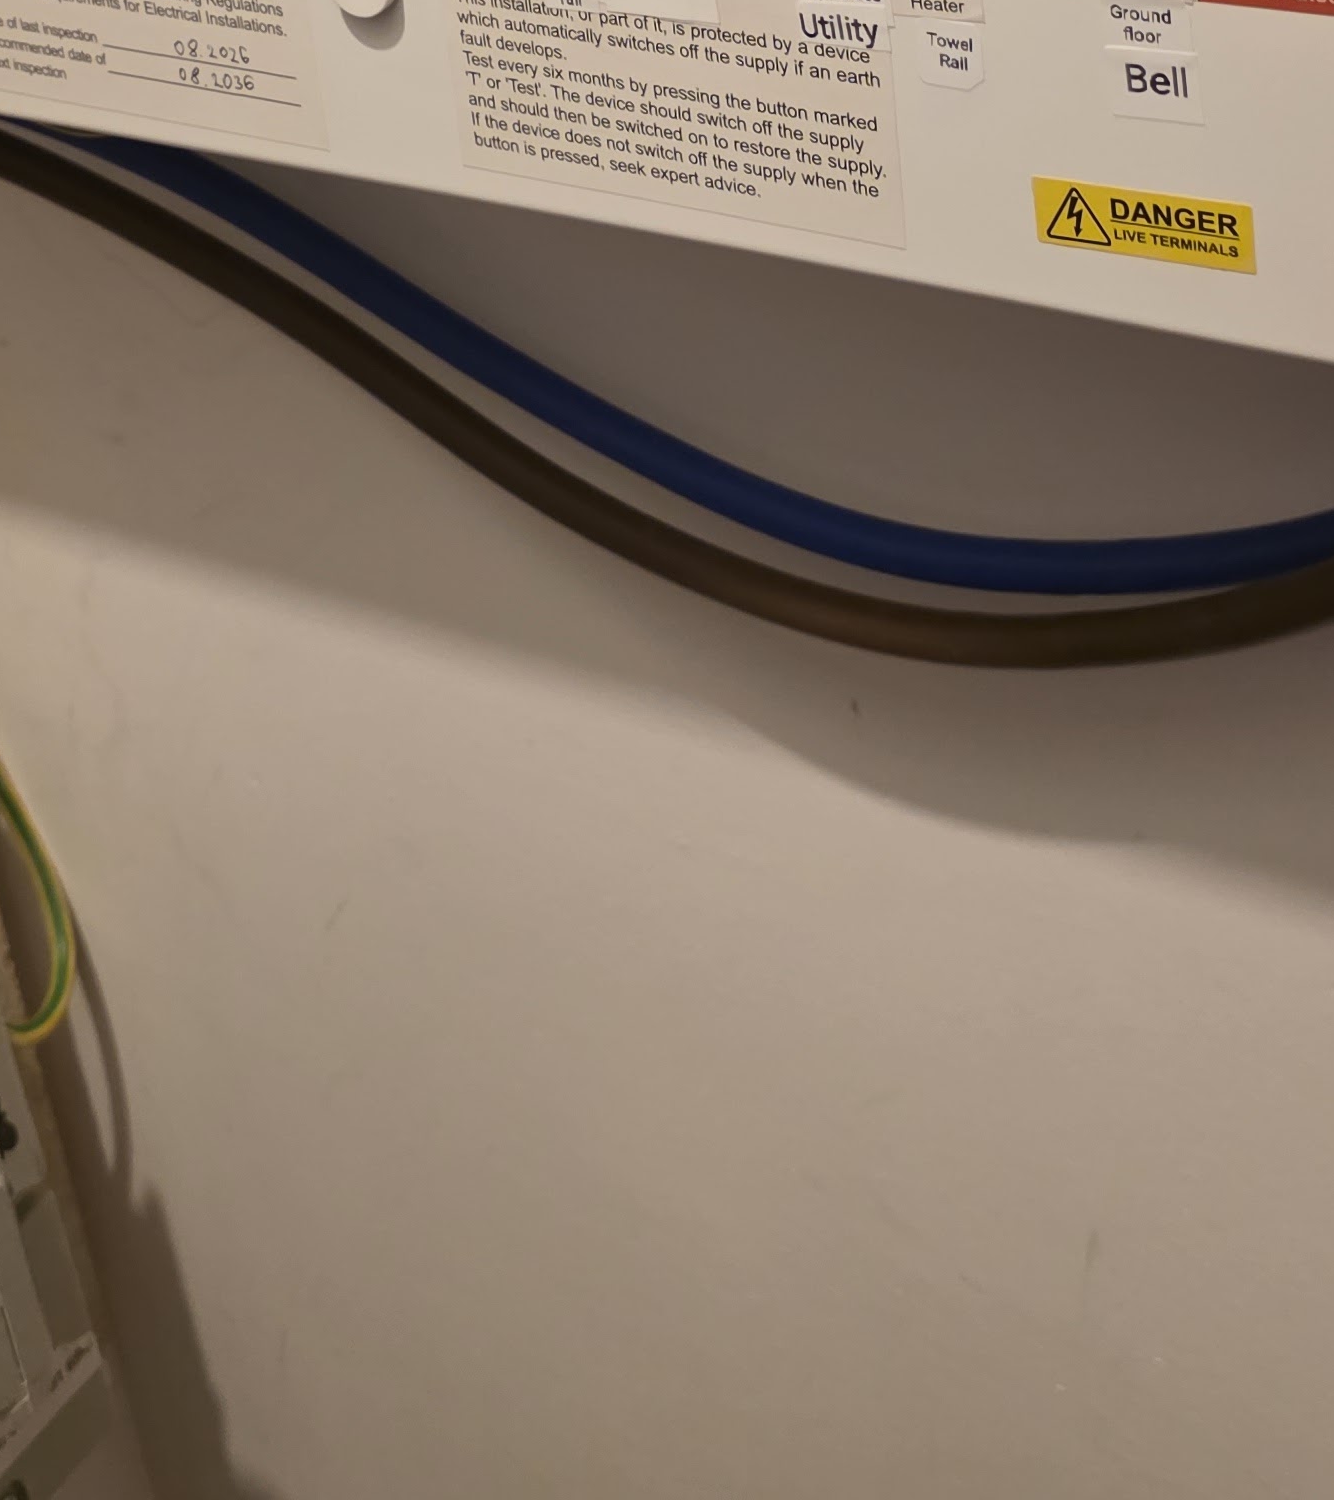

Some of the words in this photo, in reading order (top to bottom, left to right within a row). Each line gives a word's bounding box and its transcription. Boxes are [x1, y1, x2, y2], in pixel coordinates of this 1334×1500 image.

[799, 12, 878, 49] Utility
[1110, 4, 1172, 25] Ground
[457, 11, 499, 29] which
[505, 18, 602, 47] automatically
[608, 34, 675, 56] switches
[680, 45, 699, 59] off
[705, 47, 730, 64] the
[736, 54, 788, 76] supply
[794, 60, 803, 75] if
[809, 65, 830, 80] an
[837, 70, 880, 88] earth
[926, 32, 973, 52] Towel
[1123, 27, 1162, 44] floor
[939, 54, 969, 71] Rail
[463, 50, 494, 69] Test
[498, 59, 538, 78] every
[543, 65, 564, 80] six
[569, 69, 625, 90] months
[630, 77, 647, 96] by
[653, 83, 720, 108] pressing
[725, 94, 751, 110] the
[757, 98, 808, 120] button
[814, 110, 878, 132] marked
[1125, 63, 1189, 98] Bell
[474, 132, 519, 152] button
[524, 142, 536, 156] is
[541, 147, 605, 170] pressed,
[610, 159, 646, 177] seek
[651, 167, 700, 188] expert
[705, 176, 761, 198] advice.
[1110, 198, 1239, 237] DANGER
[1114, 229, 1146, 243] LIVE
[1150, 234, 1239, 257] TERMINALS
